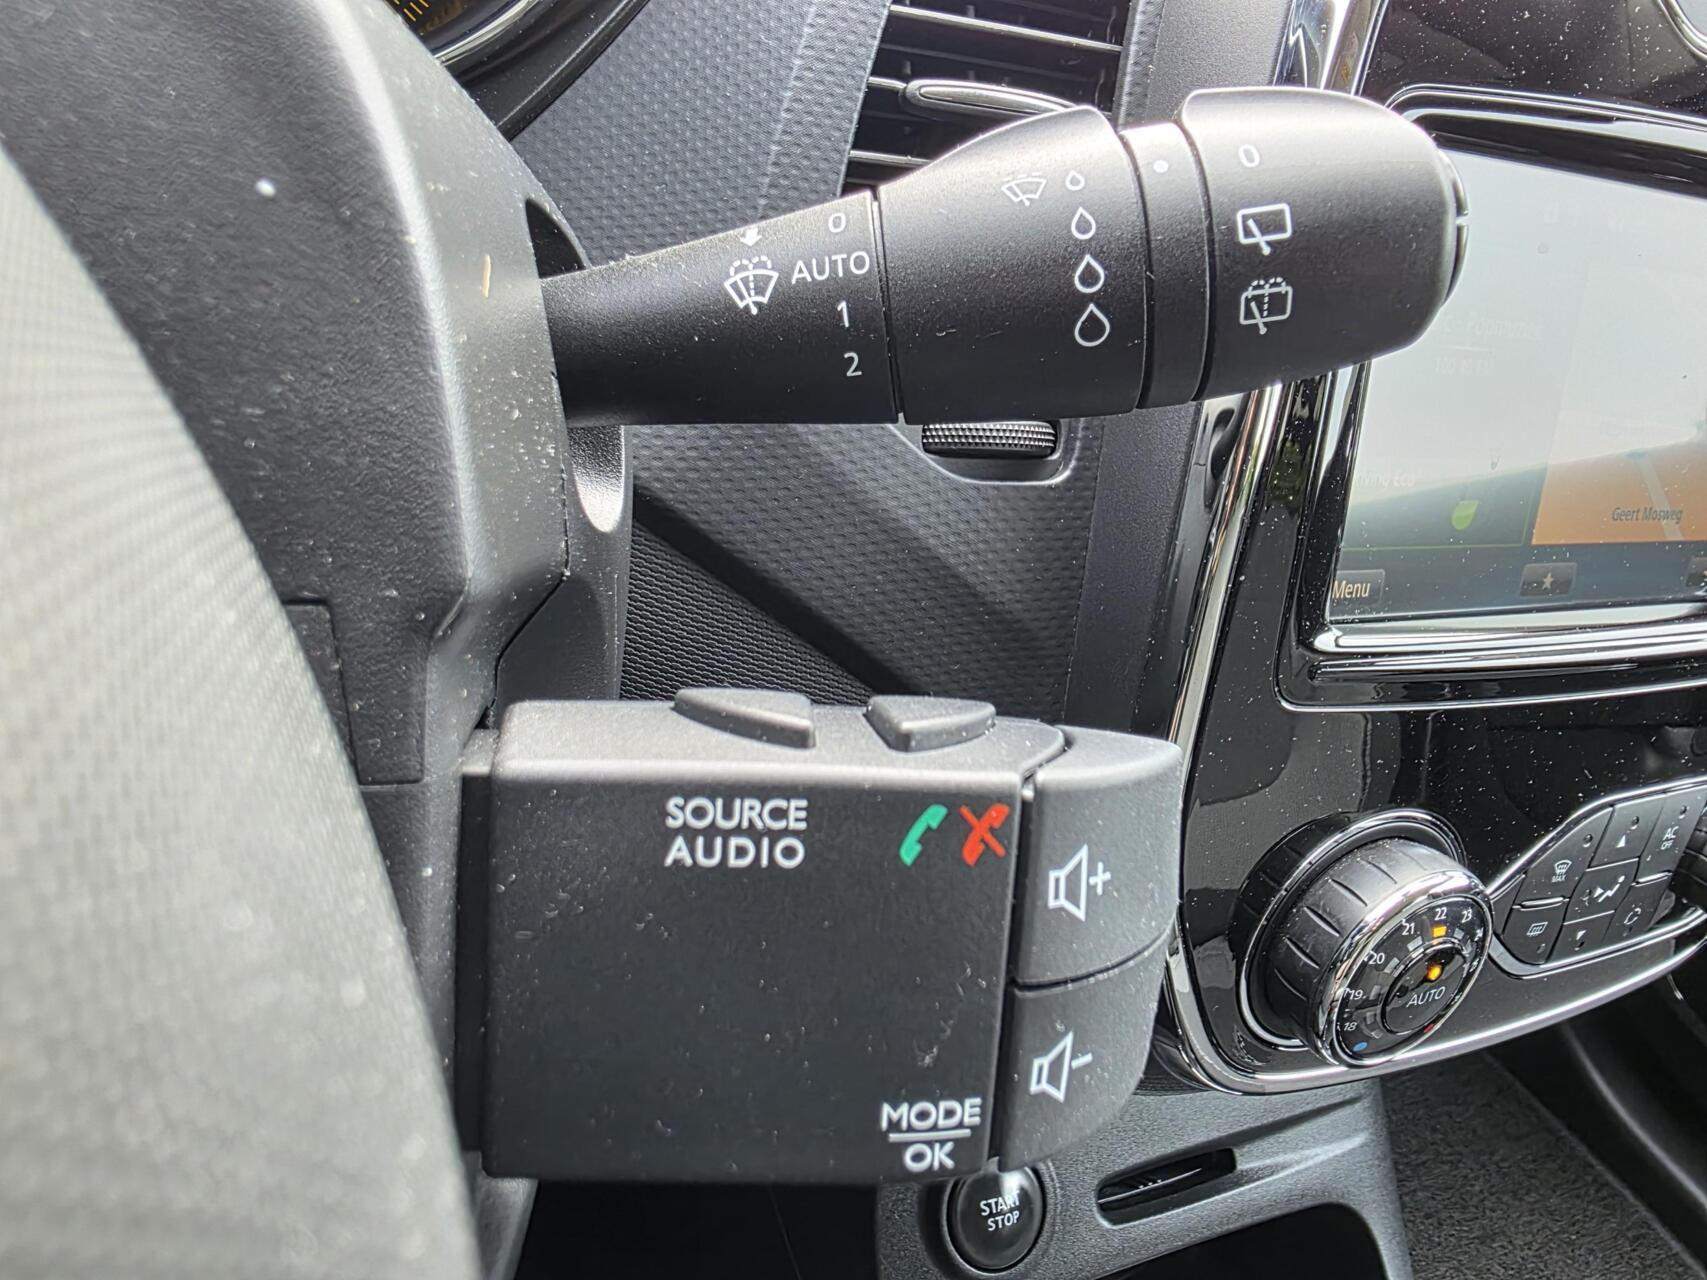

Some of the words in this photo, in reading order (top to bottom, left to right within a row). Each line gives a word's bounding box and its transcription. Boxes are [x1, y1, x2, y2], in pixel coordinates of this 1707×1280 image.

[791, 251, 870, 284] AUTO
[837, 301, 849, 328] 1
[844, 352, 862, 377] 2
[1611, 506, 1640, 522] Geert
[1332, 580, 1371, 600] Menu
[664, 796, 808, 830] SOURCE
[664, 835, 805, 869] AUDIO
[1434, 906, 1448, 921] 22
[1461, 907, 1473, 923] 23
[1401, 922, 1415, 936] 21
[1368, 952, 1386, 966] 20
[1406, 986, 1446, 1008] AUTO
[1343, 1020, 1358, 1031] 18
[880, 1097, 982, 1132] MODE
[904, 1141, 956, 1173] OK
[979, 1190, 1020, 1216] START
[987, 1211, 1020, 1232] STOP
